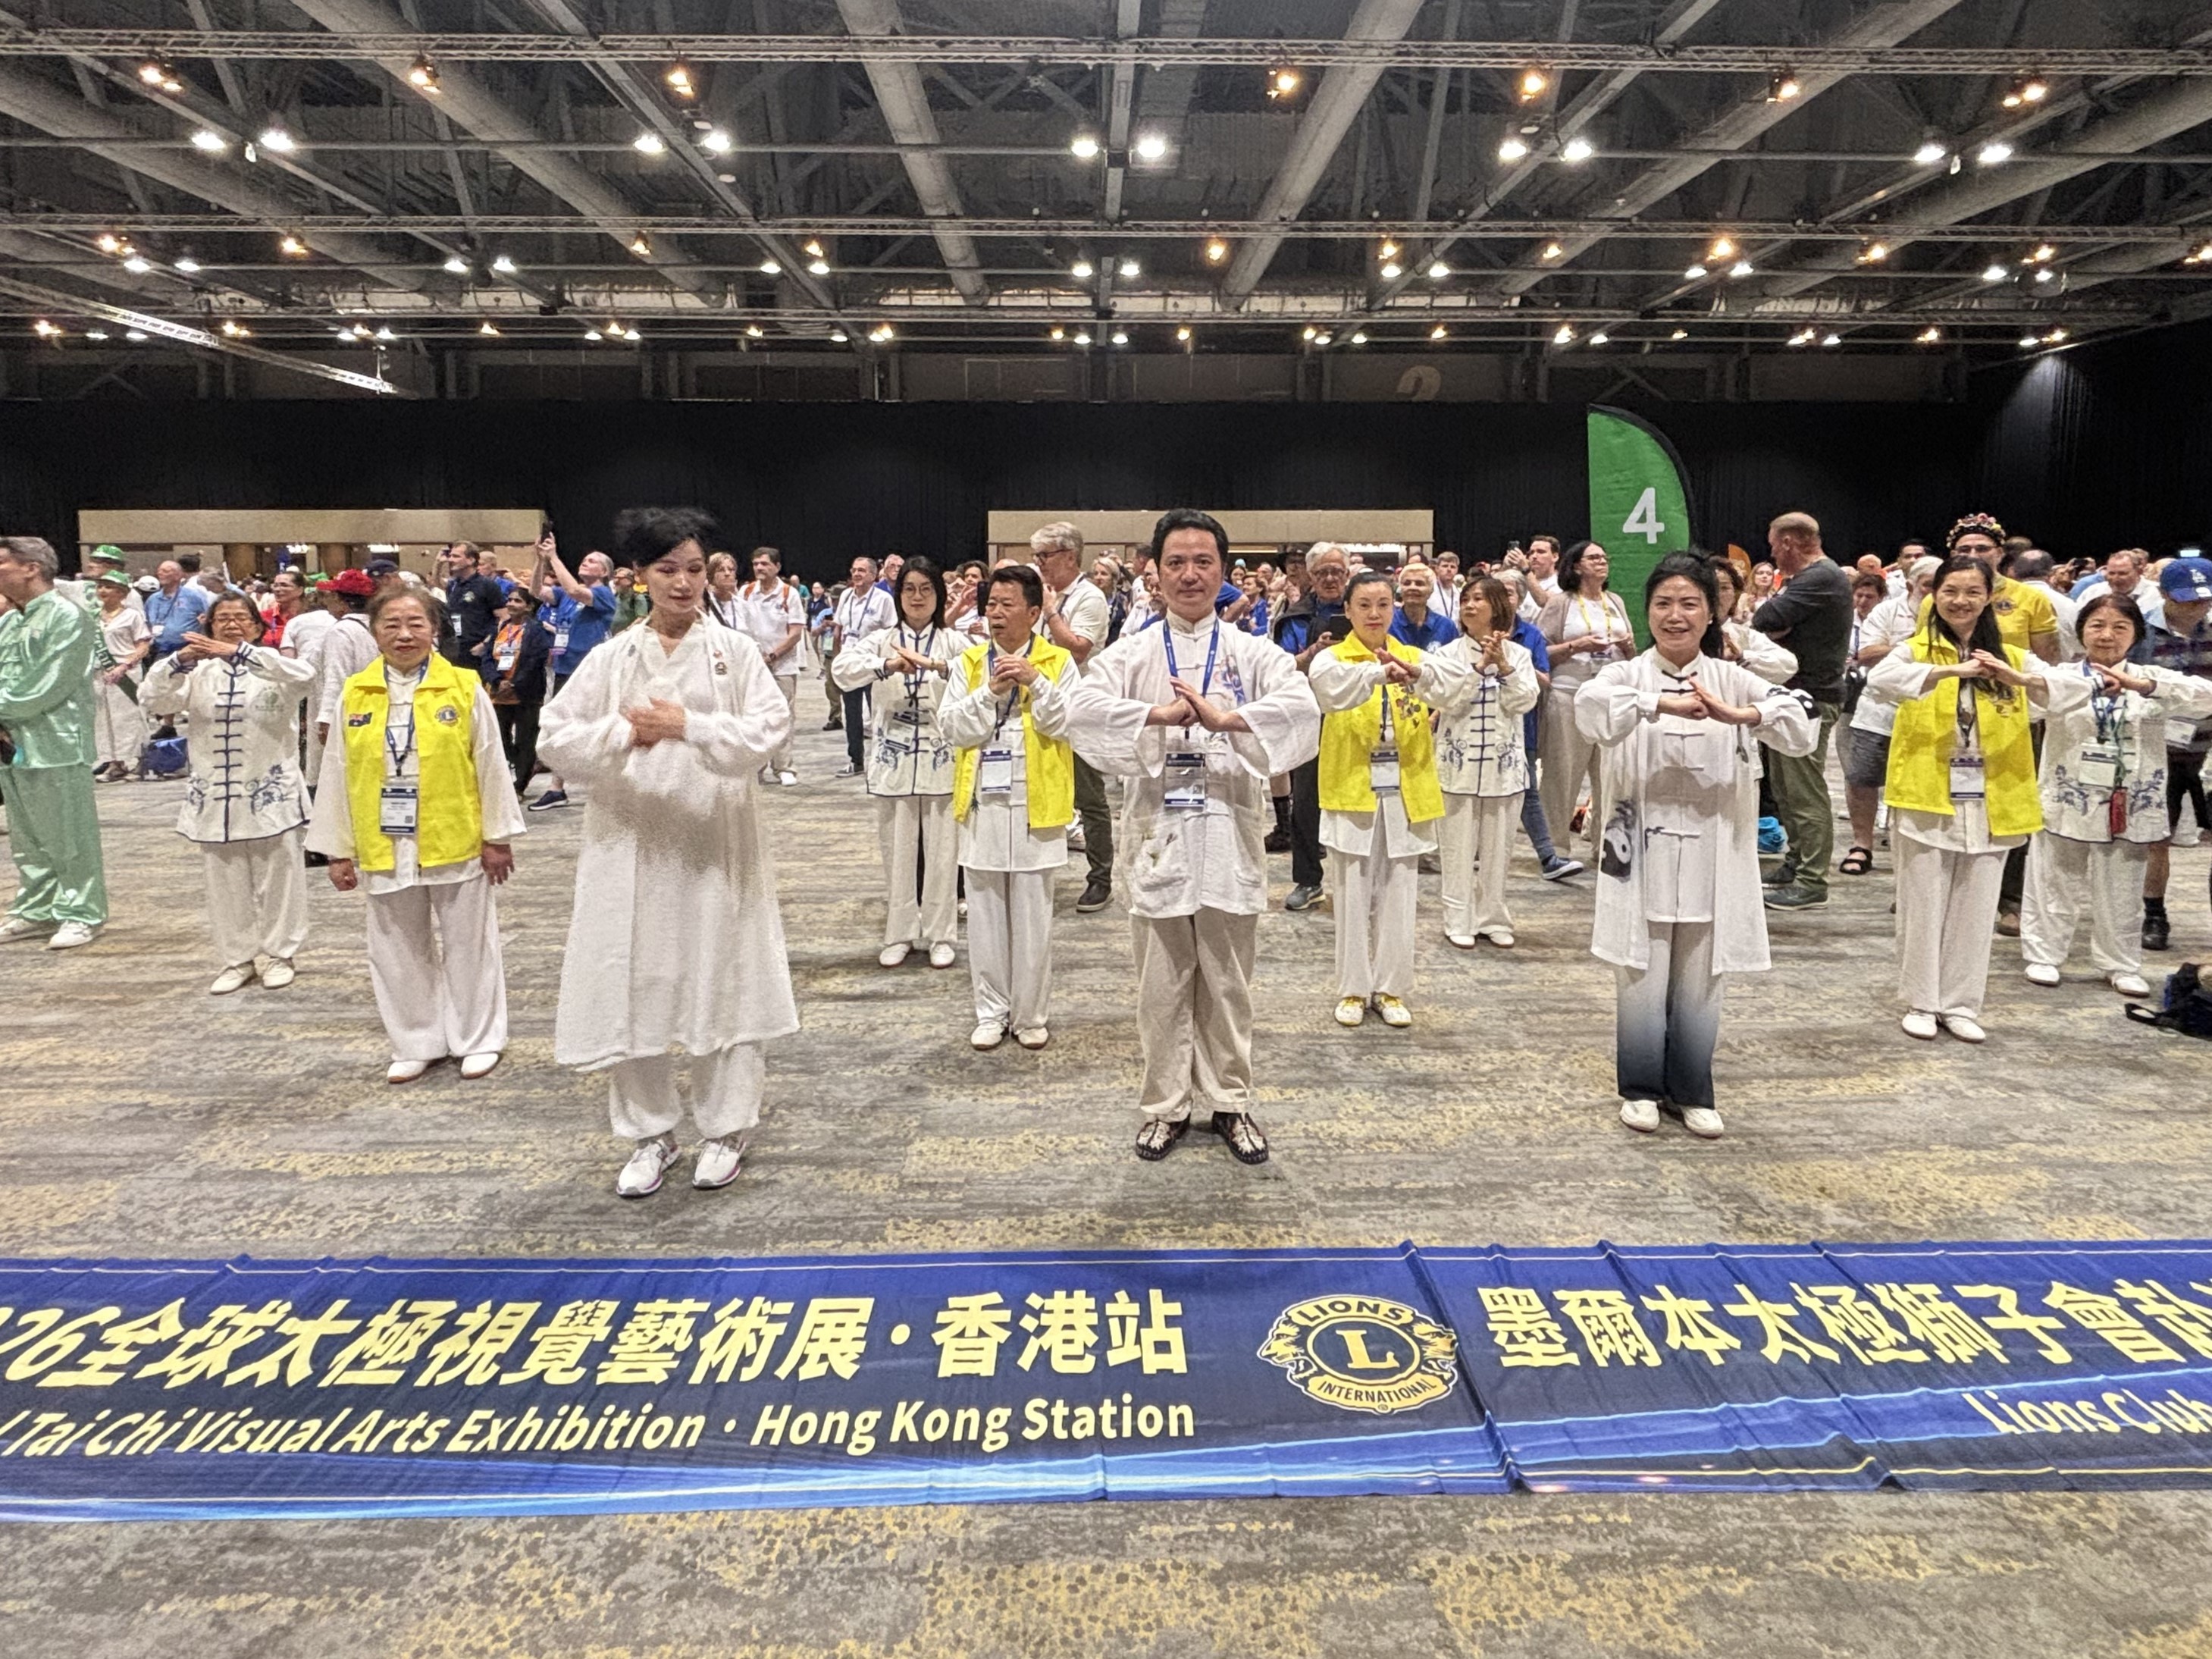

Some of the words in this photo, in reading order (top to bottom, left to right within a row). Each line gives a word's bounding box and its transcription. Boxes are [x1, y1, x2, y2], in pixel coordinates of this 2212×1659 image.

[1623, 487, 1665, 544] 4
[1296, 1300, 1406, 1323] LIONS
[1335, 1329, 1401, 1369] L
[1317, 1378, 1438, 1403] INTERNATIONAL
[1963, 1388, 2122, 1434] Lions
[2, 1410, 111, 1457] Tai
[86, 1408, 198, 1455] Chi
[175, 1408, 352, 1453] Visual
[329, 1410, 451, 1452] Arts
[445, 1403, 706, 1452] Exhibition
[750, 1405, 882, 1456] Hong
[890, 1401, 1012, 1453] Kong
[1022, 1395, 1194, 1440] Station
